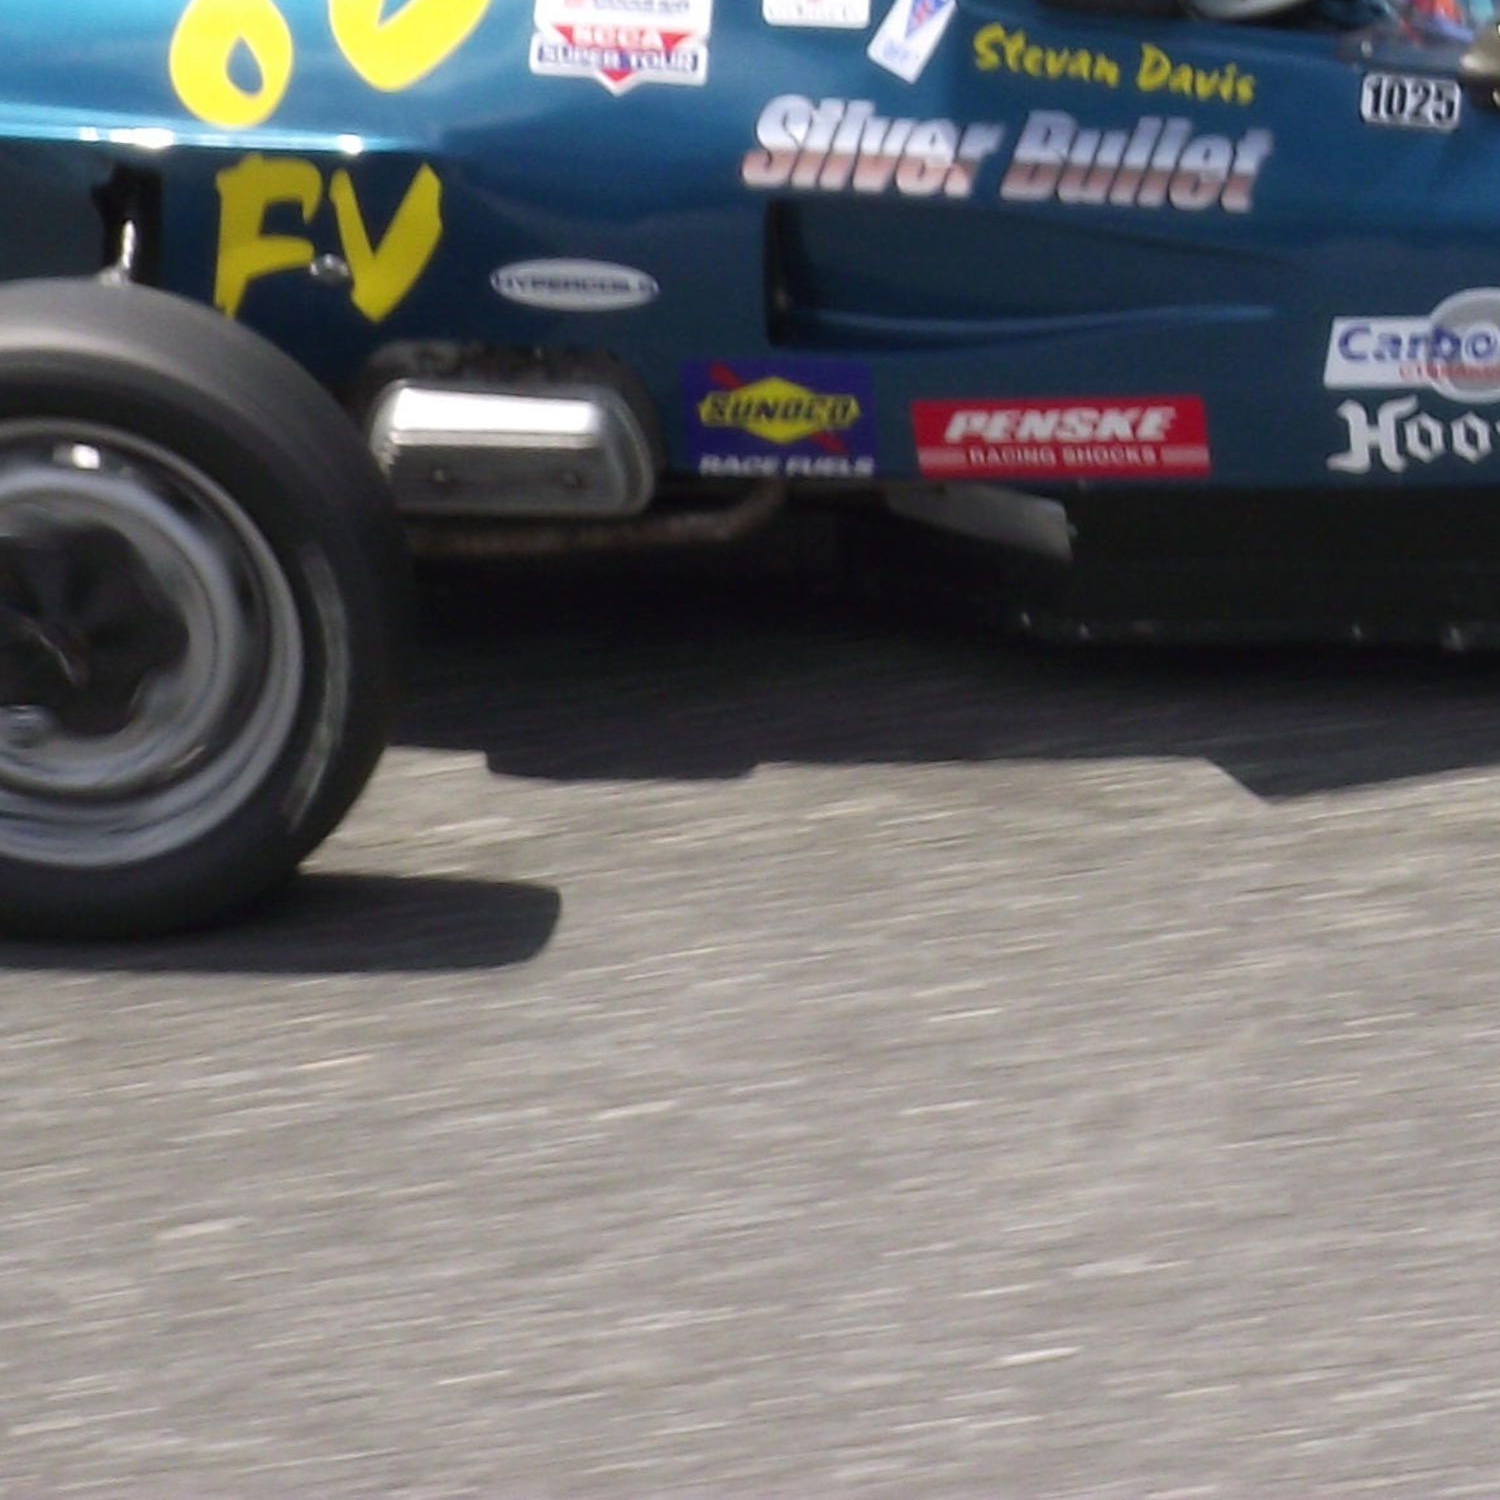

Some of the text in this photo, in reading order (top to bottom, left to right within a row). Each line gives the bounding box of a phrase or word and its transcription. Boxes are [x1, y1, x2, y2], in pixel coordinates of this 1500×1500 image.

[542, 44, 695, 71] SUPER TOUR
[973, 22, 1254, 105] Stevan Davis
[1371, 80, 1456, 121] 1025
[740, 94, 1274, 213] Silver Bullet
[213, 151, 443, 323] FV
[704, 391, 855, 427] SUNOCO
[944, 406, 1176, 443] PENSKE
[699, 454, 875, 477] RACE FUELS
[968, 445, 1158, 465] RACING SHOCKS
